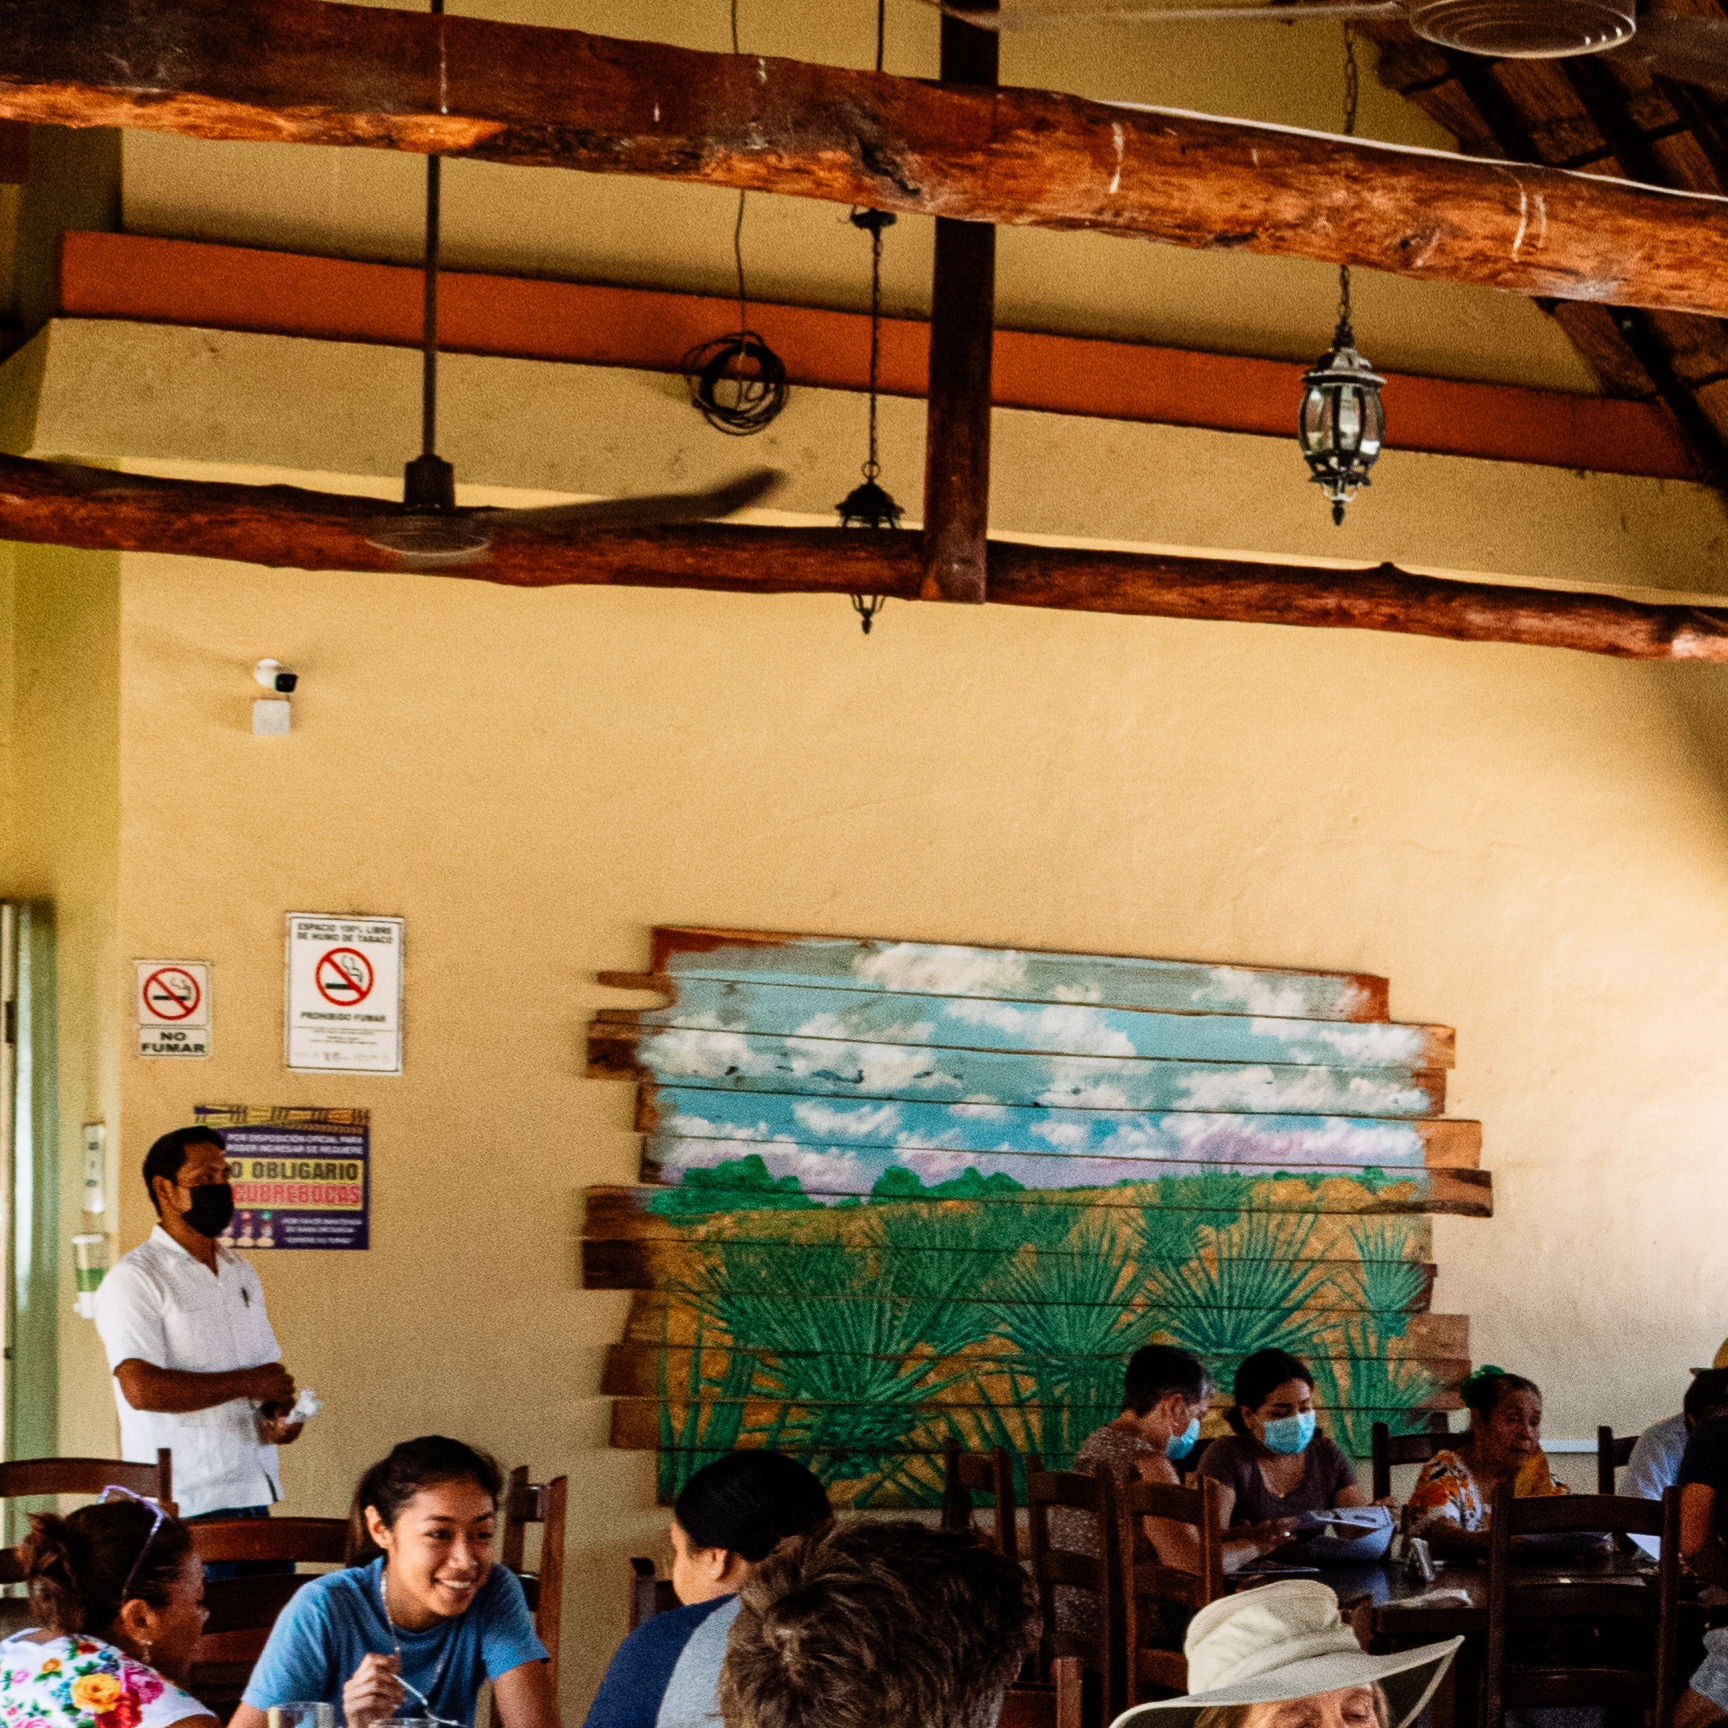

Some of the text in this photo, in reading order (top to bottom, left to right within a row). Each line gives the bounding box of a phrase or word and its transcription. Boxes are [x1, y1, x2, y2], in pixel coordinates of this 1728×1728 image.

[160, 1032, 187, 1041] NO
[141, 1043, 206, 1053] FUMAR
[252, 1161, 359, 1180] OBLIGARIO
